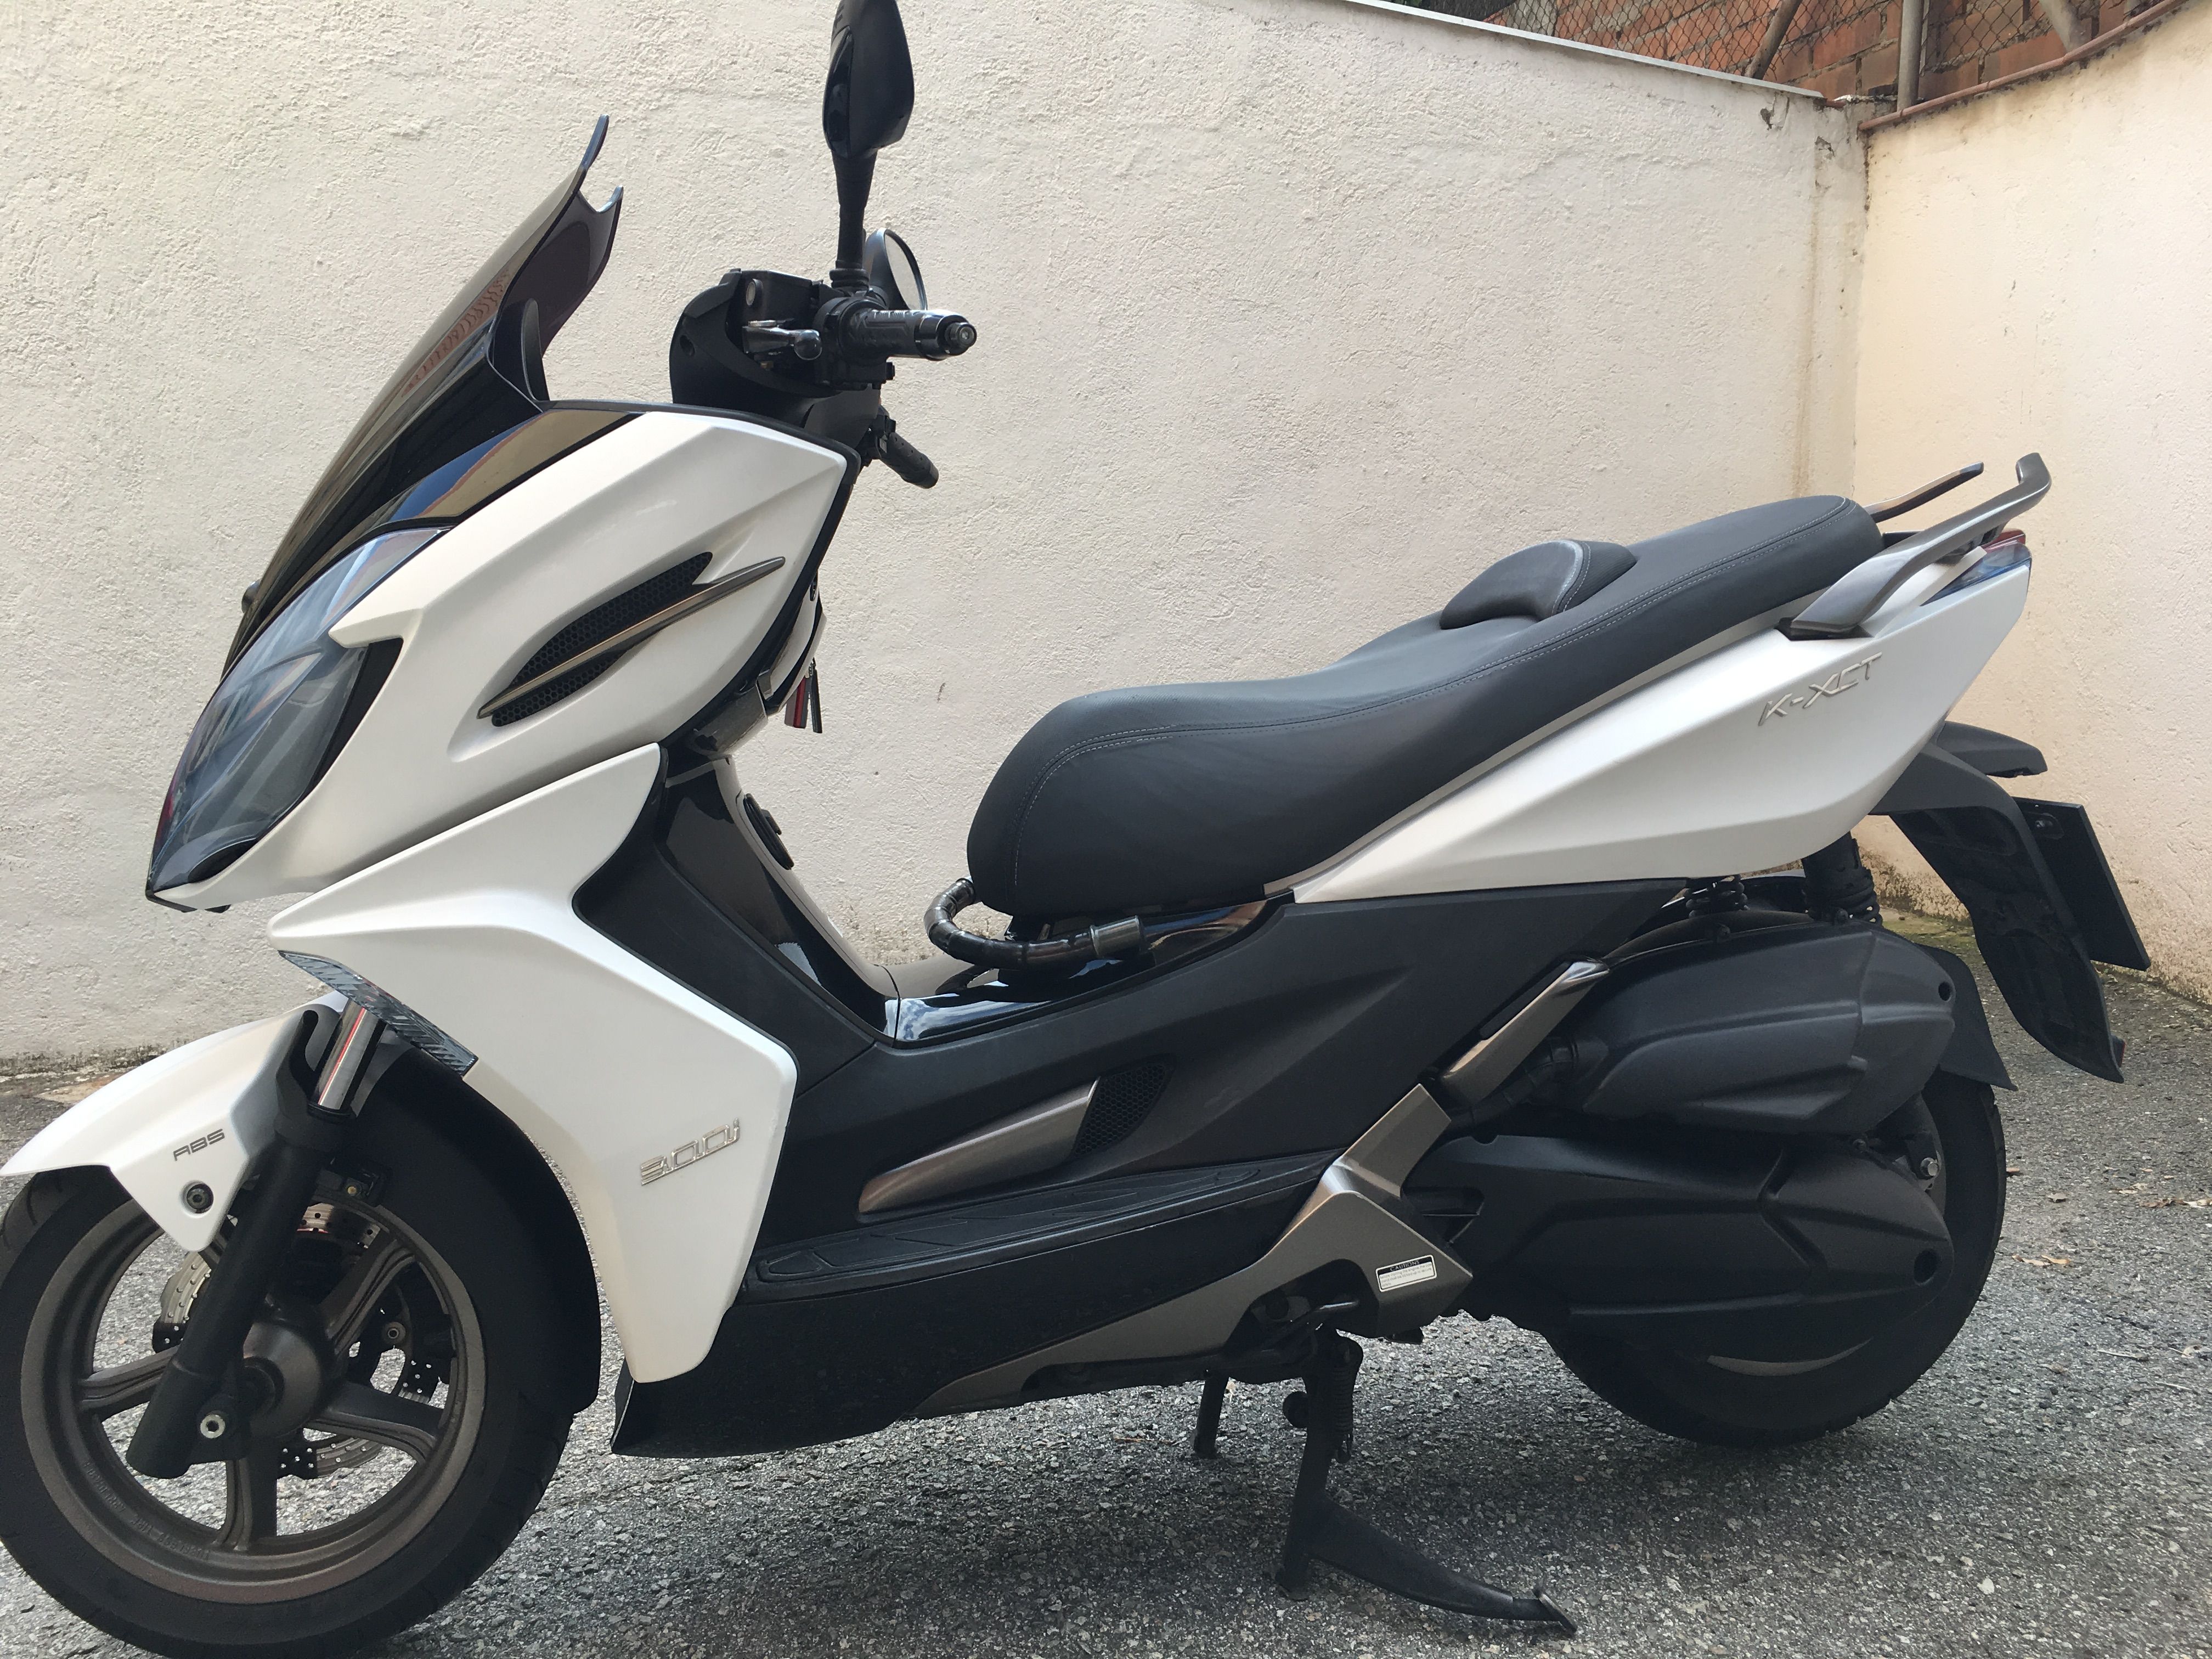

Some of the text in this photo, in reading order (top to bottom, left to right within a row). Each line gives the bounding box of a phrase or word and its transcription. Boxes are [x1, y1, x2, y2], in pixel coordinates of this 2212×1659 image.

[1758, 651, 1882, 726] K-XCT
[173, 1128, 225, 1161] ABS
[640, 1118, 741, 1186] 300i
[1390, 1260, 1420, 1272] CAUTIONS
